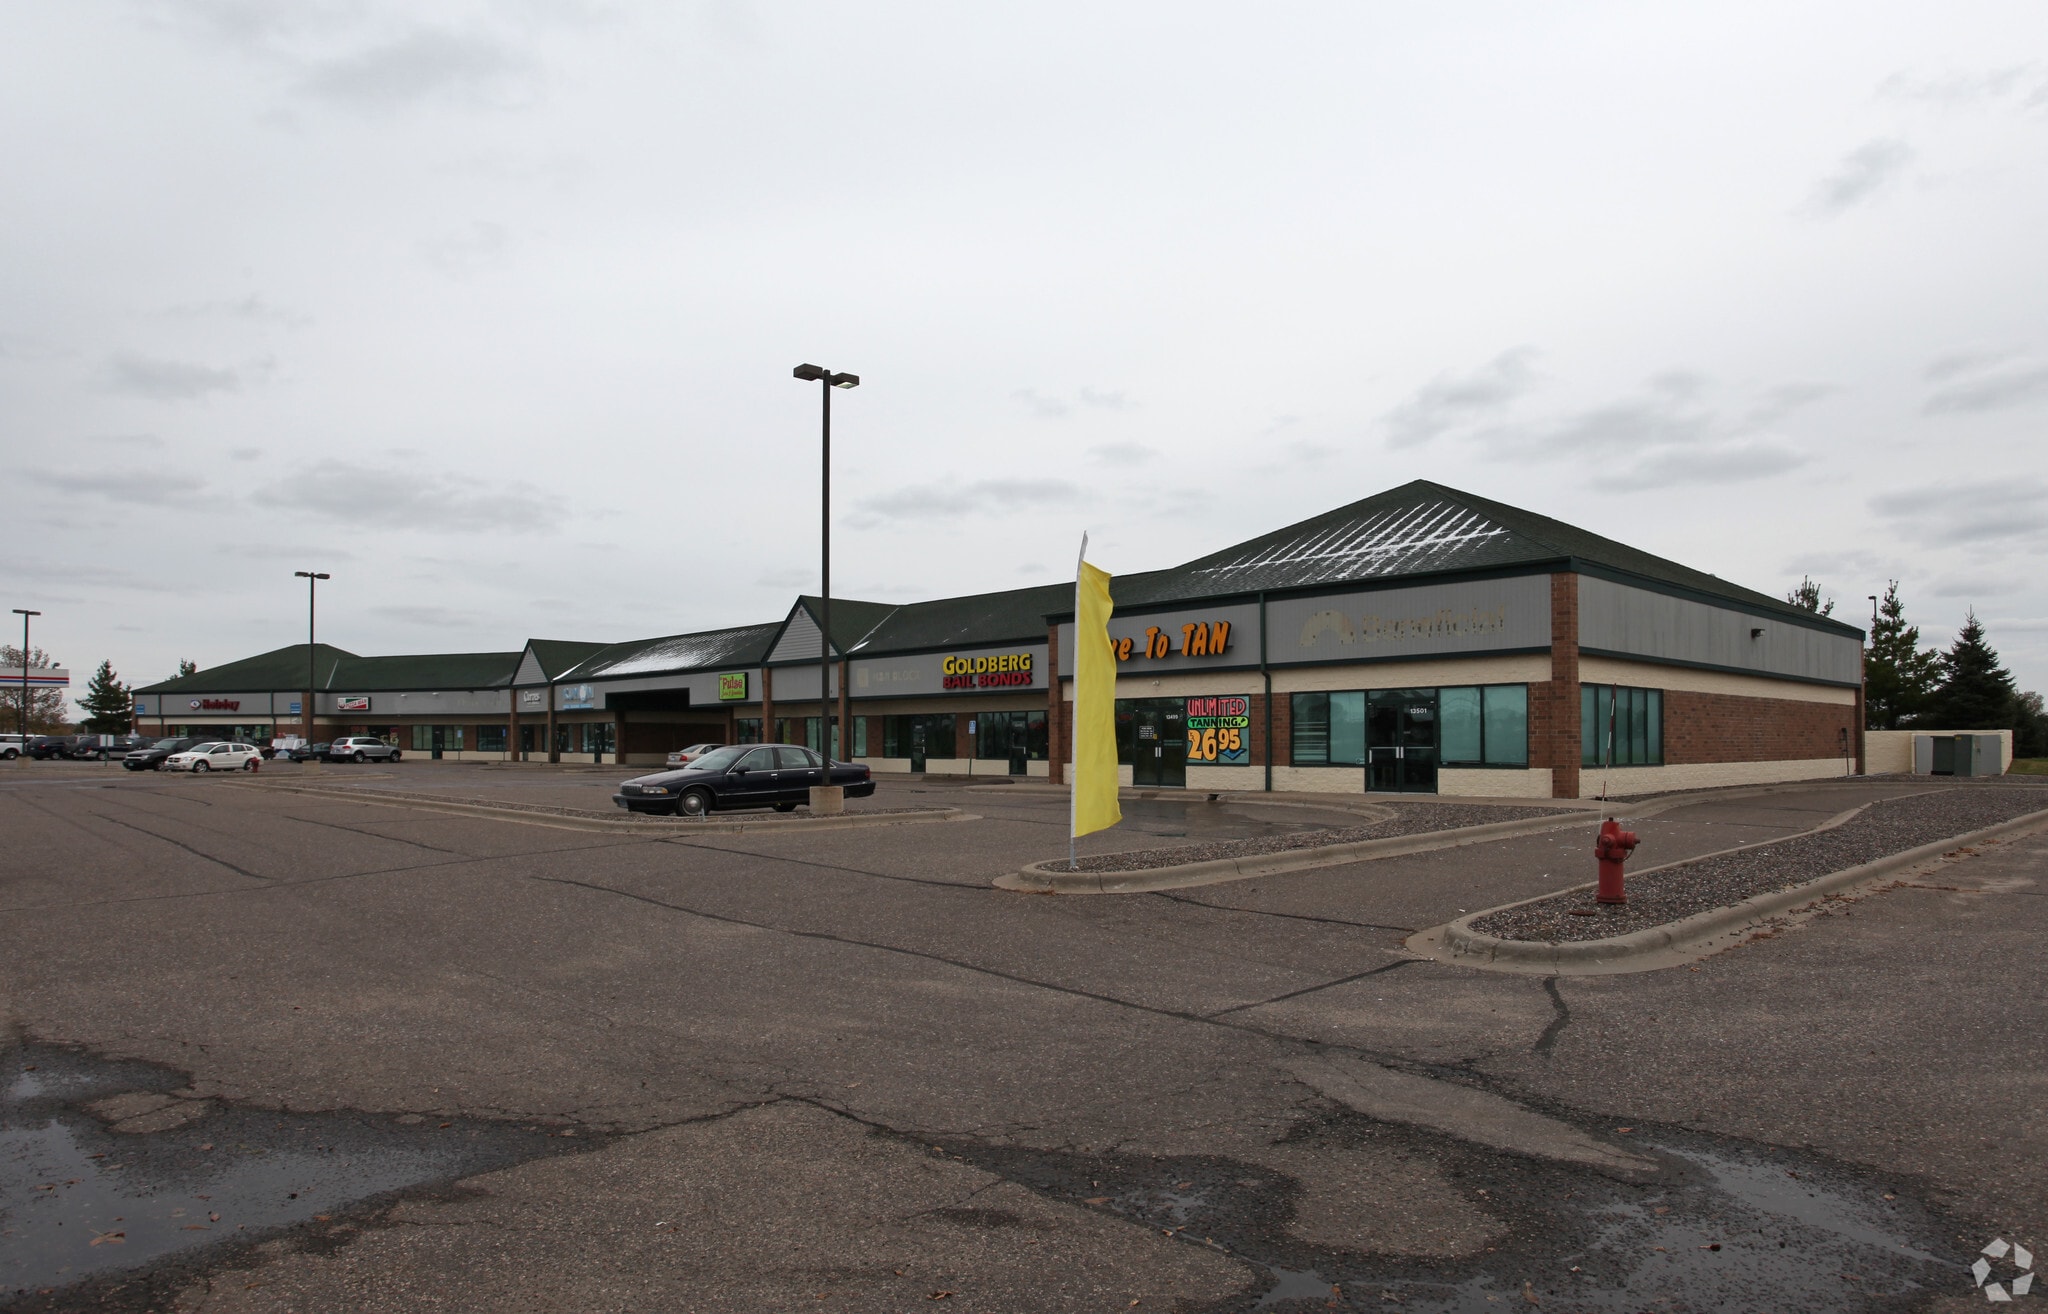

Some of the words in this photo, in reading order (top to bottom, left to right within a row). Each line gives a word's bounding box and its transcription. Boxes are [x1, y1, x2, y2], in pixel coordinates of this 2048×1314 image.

[1145, 626, 1168, 659] To
[1181, 621, 1230, 656] TAN
[942, 653, 1032, 675] GOLDBERG
[943, 675, 975, 689] BAIL
[978, 671, 1033, 688] BONDS
[1188, 697, 1246, 717] UNLIMITED
